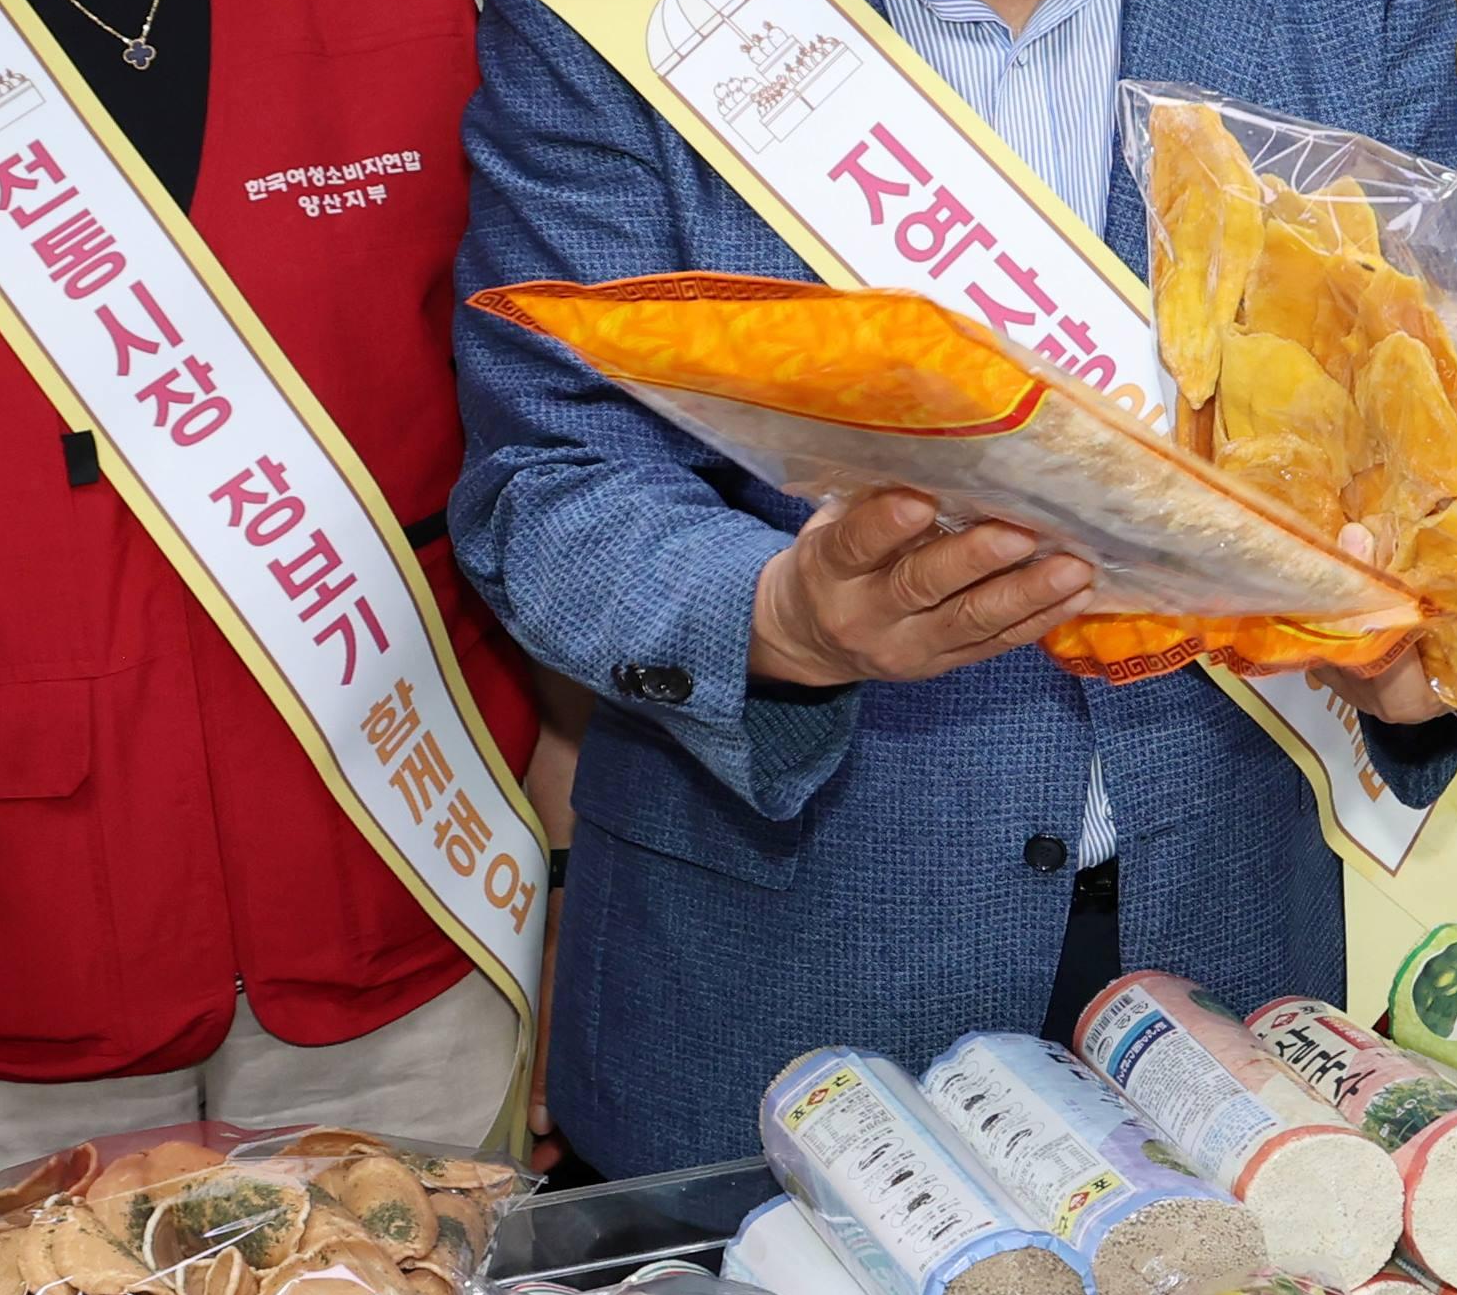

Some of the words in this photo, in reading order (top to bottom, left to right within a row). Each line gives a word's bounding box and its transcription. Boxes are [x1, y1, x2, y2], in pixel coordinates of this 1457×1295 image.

[244, 151, 422, 202] 한국여성소비자연합
[298, 184, 388, 218] 양산지부
[209, 454, 393, 687] 장보기
